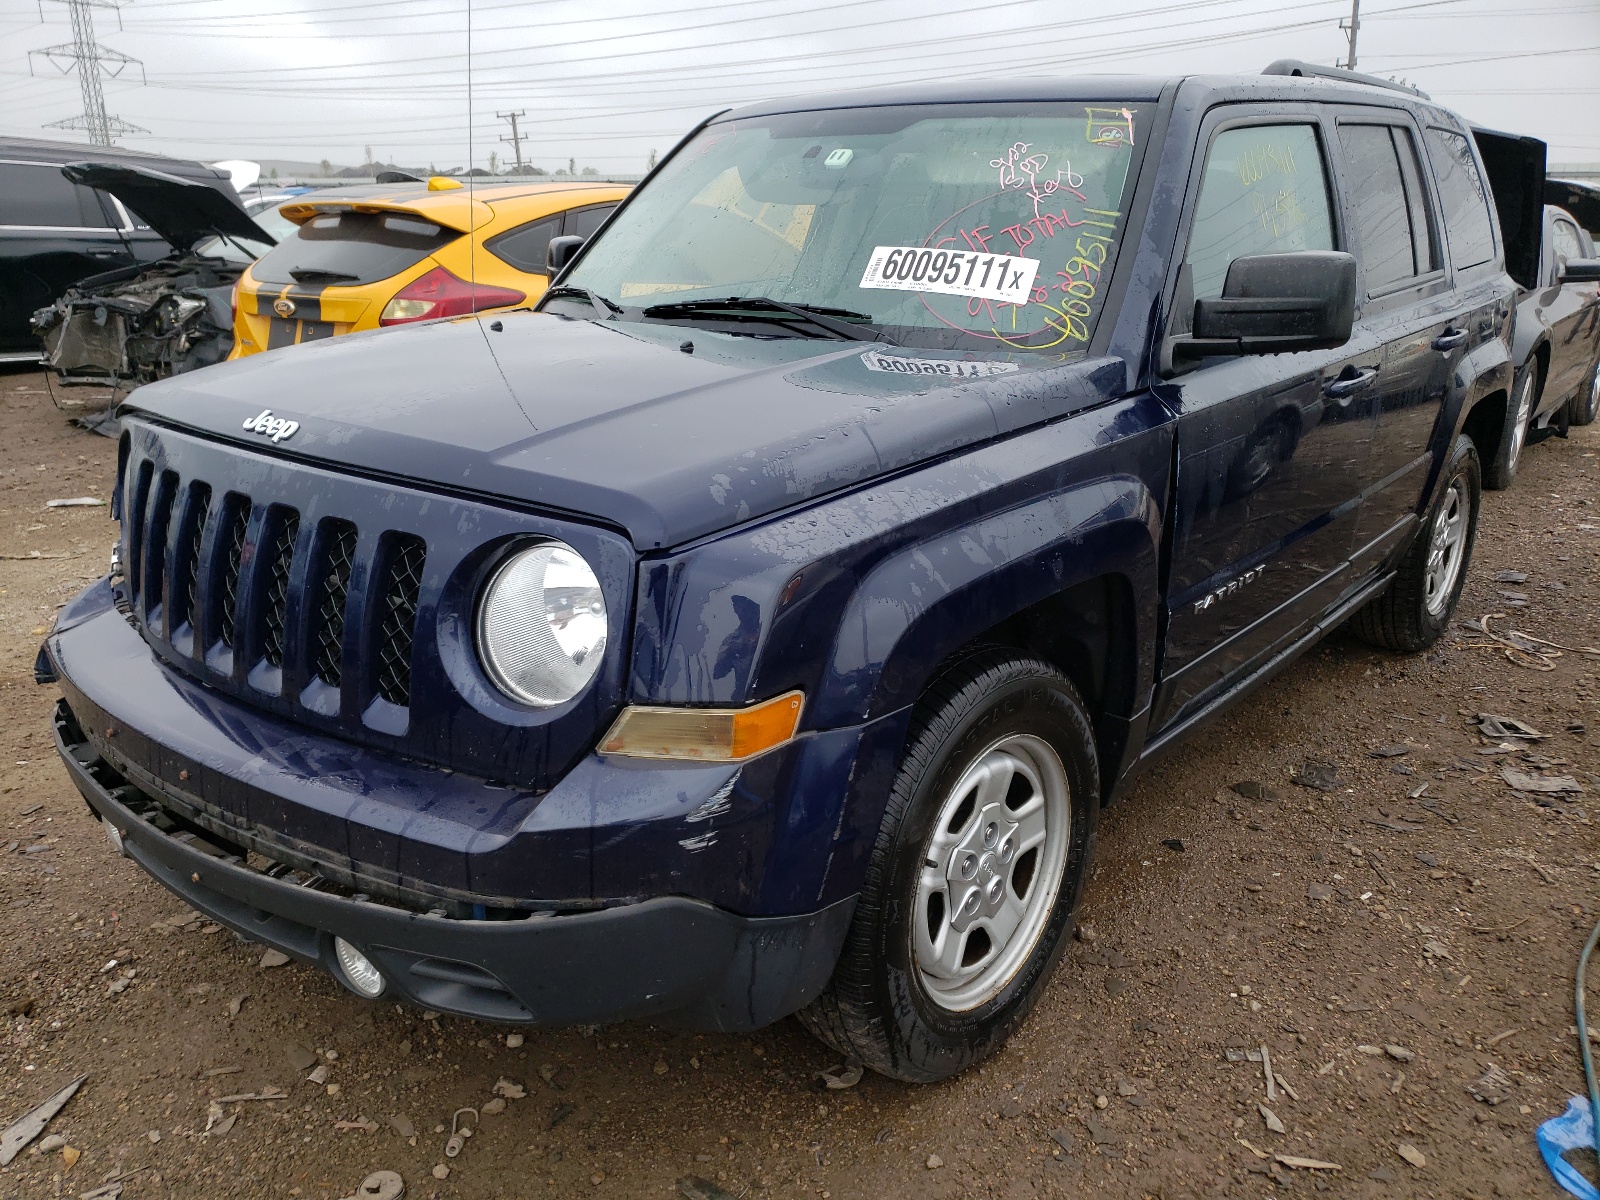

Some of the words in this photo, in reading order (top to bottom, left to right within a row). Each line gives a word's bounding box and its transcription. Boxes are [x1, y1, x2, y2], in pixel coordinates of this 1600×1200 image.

[1000, 208, 1086, 248] TOTAL
[242, 409, 300, 443] Jeep
[1192, 563, 1267, 615] PATRIOT
